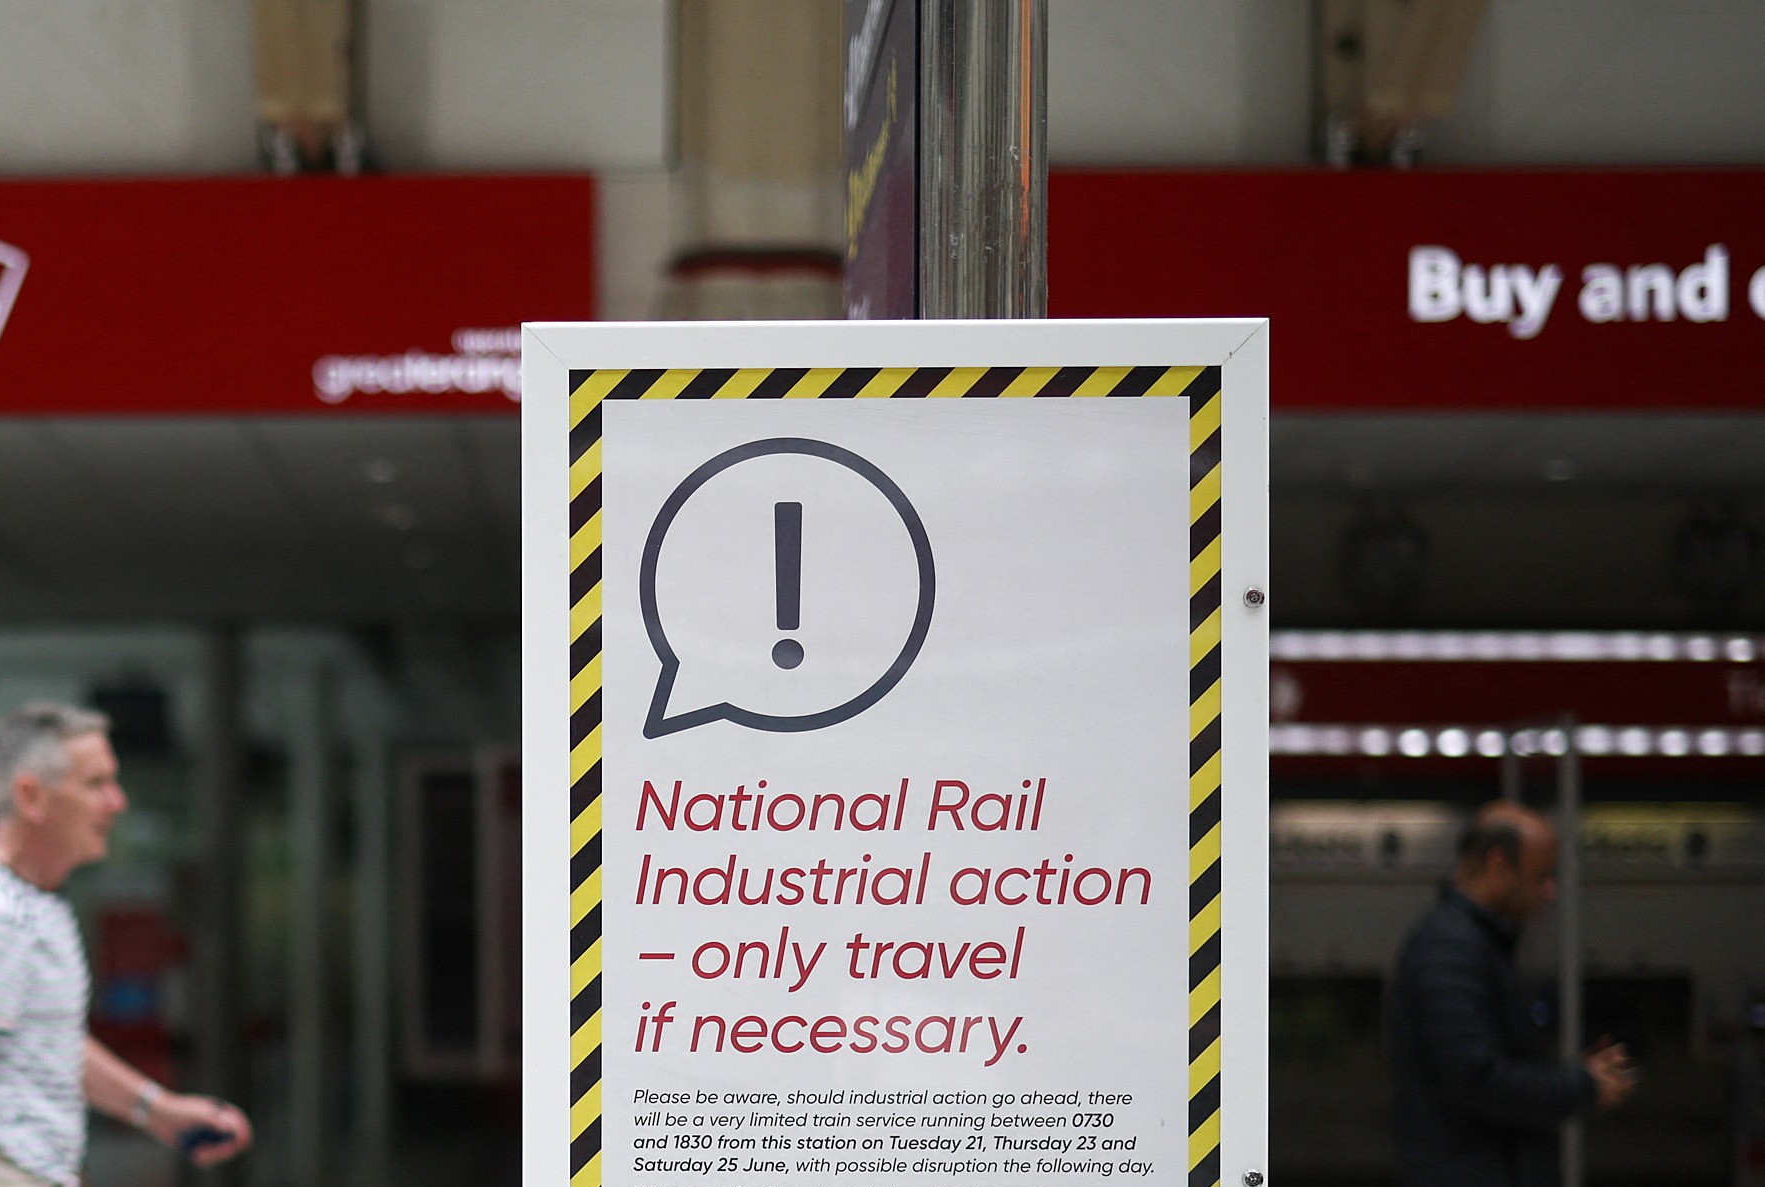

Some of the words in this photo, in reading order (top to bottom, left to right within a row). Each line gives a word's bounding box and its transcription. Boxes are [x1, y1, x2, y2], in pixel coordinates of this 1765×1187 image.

[1407, 244, 1565, 340] Buy
[1577, 242, 1730, 324] and
[635, 777, 910, 832] National
[927, 777, 1047, 832] Rail
[635, 851, 932, 906] Industrial
[949, 853, 1152, 906] action
[691, 925, 828, 993] only
[845, 926, 1026, 980] travel
[634, 1000, 677, 1054] if
[689, 1010, 1029, 1067] necessary.
[633, 1088, 691, 1104] Please
[695, 1089, 719, 1104] be
[723, 1093, 781, 1107] aware,
[786, 1089, 845, 1105] should
[849, 1089, 929, 1105] industrial
[932, 1090, 987, 1105] action
[992, 1093, 1016, 1108] go
[1020, 1090, 1082, 1108] ahead,
[1087, 1090, 1133, 1106] there
[634, 1111, 661, 1127] will
[664, 1112, 688, 1127] be
[692, 1115, 705, 1127] a
[709, 1115, 746, 1131] very
[749, 1111, 808, 1127] limited
[812, 1112, 851, 1127] train
[855, 1112, 916, 1128] service
[920, 1112, 986, 1131] running
[990, 1112, 1067, 1128] between
[1071, 1112, 1114, 1128] 0730
[633, 1134, 669, 1149] and
[673, 1134, 713, 1150] 1830
[717, 1134, 756, 1150] from
[761, 1134, 792, 1150] this
[796, 1135, 857, 1150] station
[861, 1138, 884, 1150] on
[889, 1135, 962, 1154] Tuesday
[965, 1135, 987, 1153] 21,
[993, 1135, 1073, 1154] Thursday
[1075, 1135, 1098, 1151] 23
[1101, 1135, 1137, 1151] and
[633, 1156, 714, 1176] Saturday
[716, 1157, 739, 1173] 25
[742, 1157, 790, 1175] June,
[796, 1157, 831, 1173] with
[834, 1157, 908, 1176] possible
[912, 1157, 998, 1177] disruption
[1003, 1158, 1032, 1173] the
[1036, 1157, 1114, 1177] following
[1118, 1158, 1155, 1177] day.
